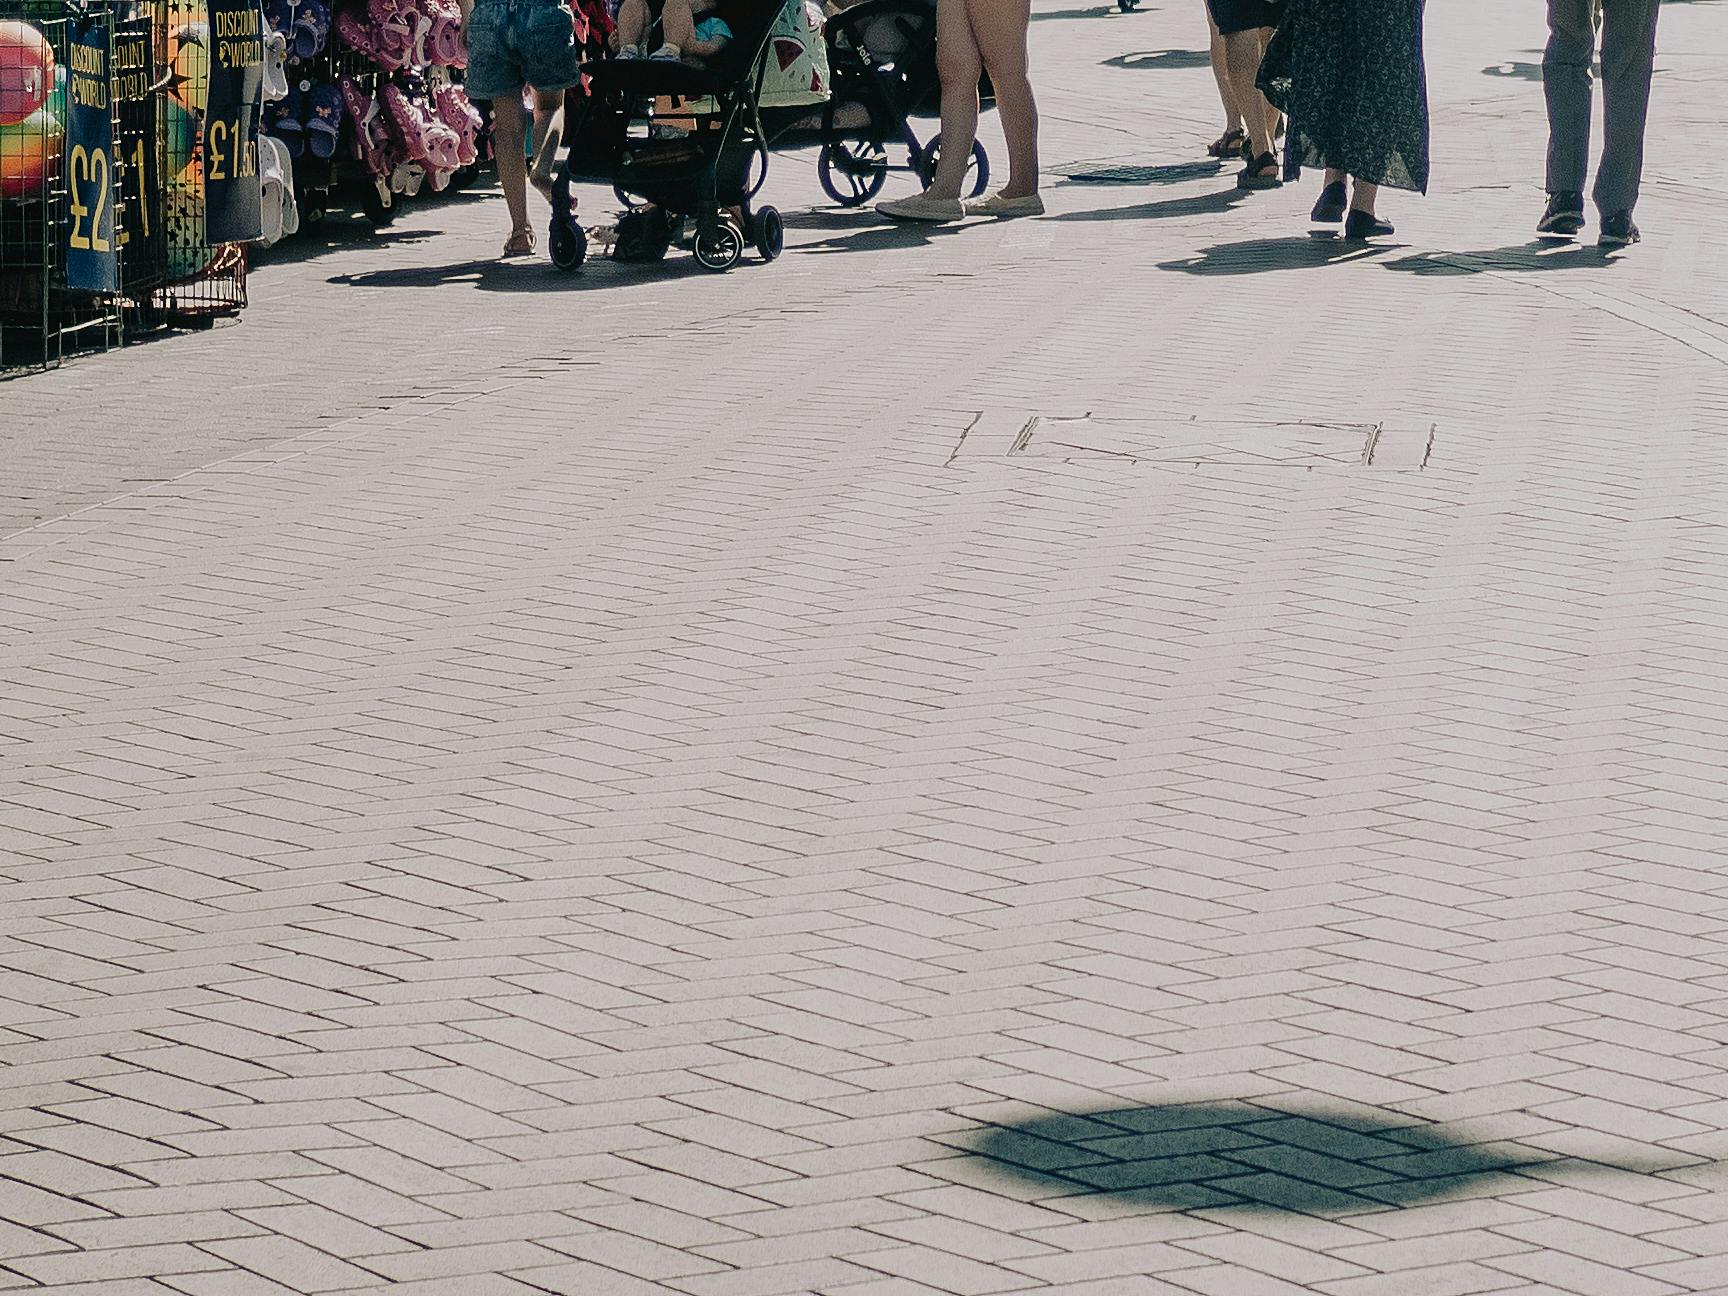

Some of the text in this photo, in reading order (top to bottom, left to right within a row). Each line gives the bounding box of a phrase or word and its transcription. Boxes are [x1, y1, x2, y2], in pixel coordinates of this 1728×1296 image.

[216, 8, 259, 38] DISCOUNT
[71, 43, 104, 77] DISCOUNT
[230, 41, 260, 67] WORLD
[856, 44, 872, 66] Joie
[78, 79, 106, 109] WORLD
[210, 119, 257, 180] £1.50
[70, 144, 110, 252] £2
